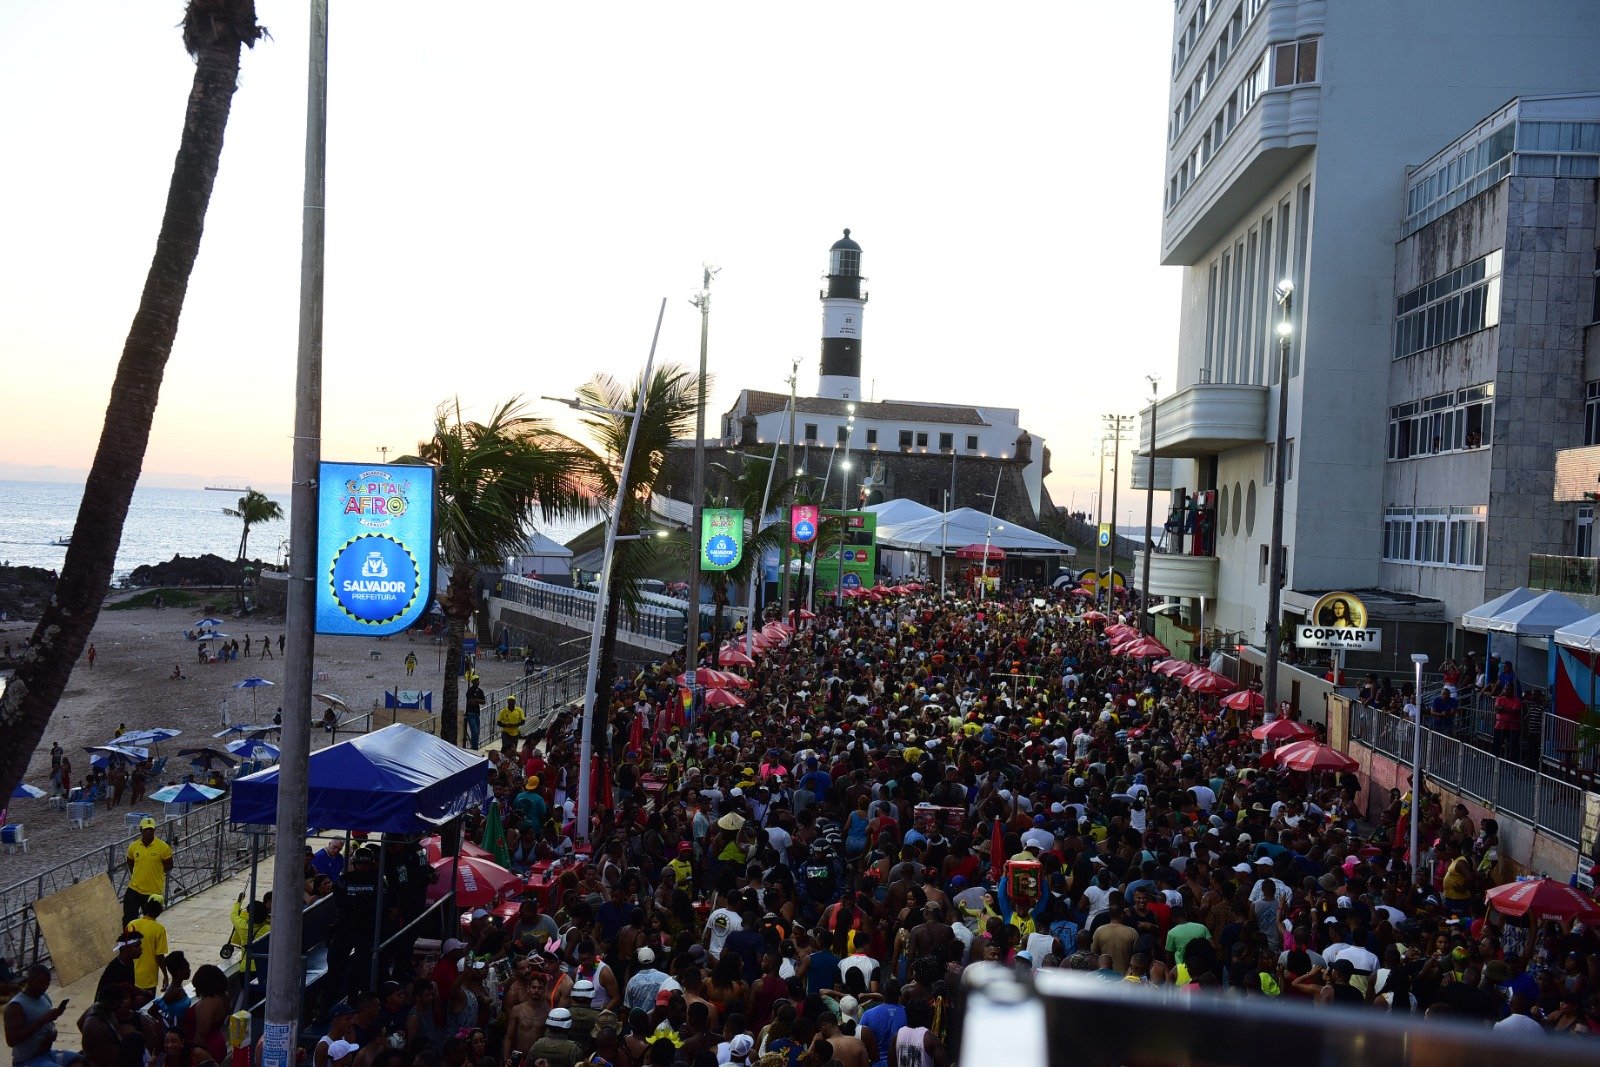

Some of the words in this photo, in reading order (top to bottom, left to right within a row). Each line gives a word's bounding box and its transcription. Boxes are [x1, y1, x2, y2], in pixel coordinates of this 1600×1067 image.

[346, 480, 405, 494] CAPITAL
[344, 496, 406, 515] AFRO
[343, 580, 405, 593] SALVADOR
[352, 593, 396, 601] PREFEITURA
[1303, 628, 1376, 641] COPYART
